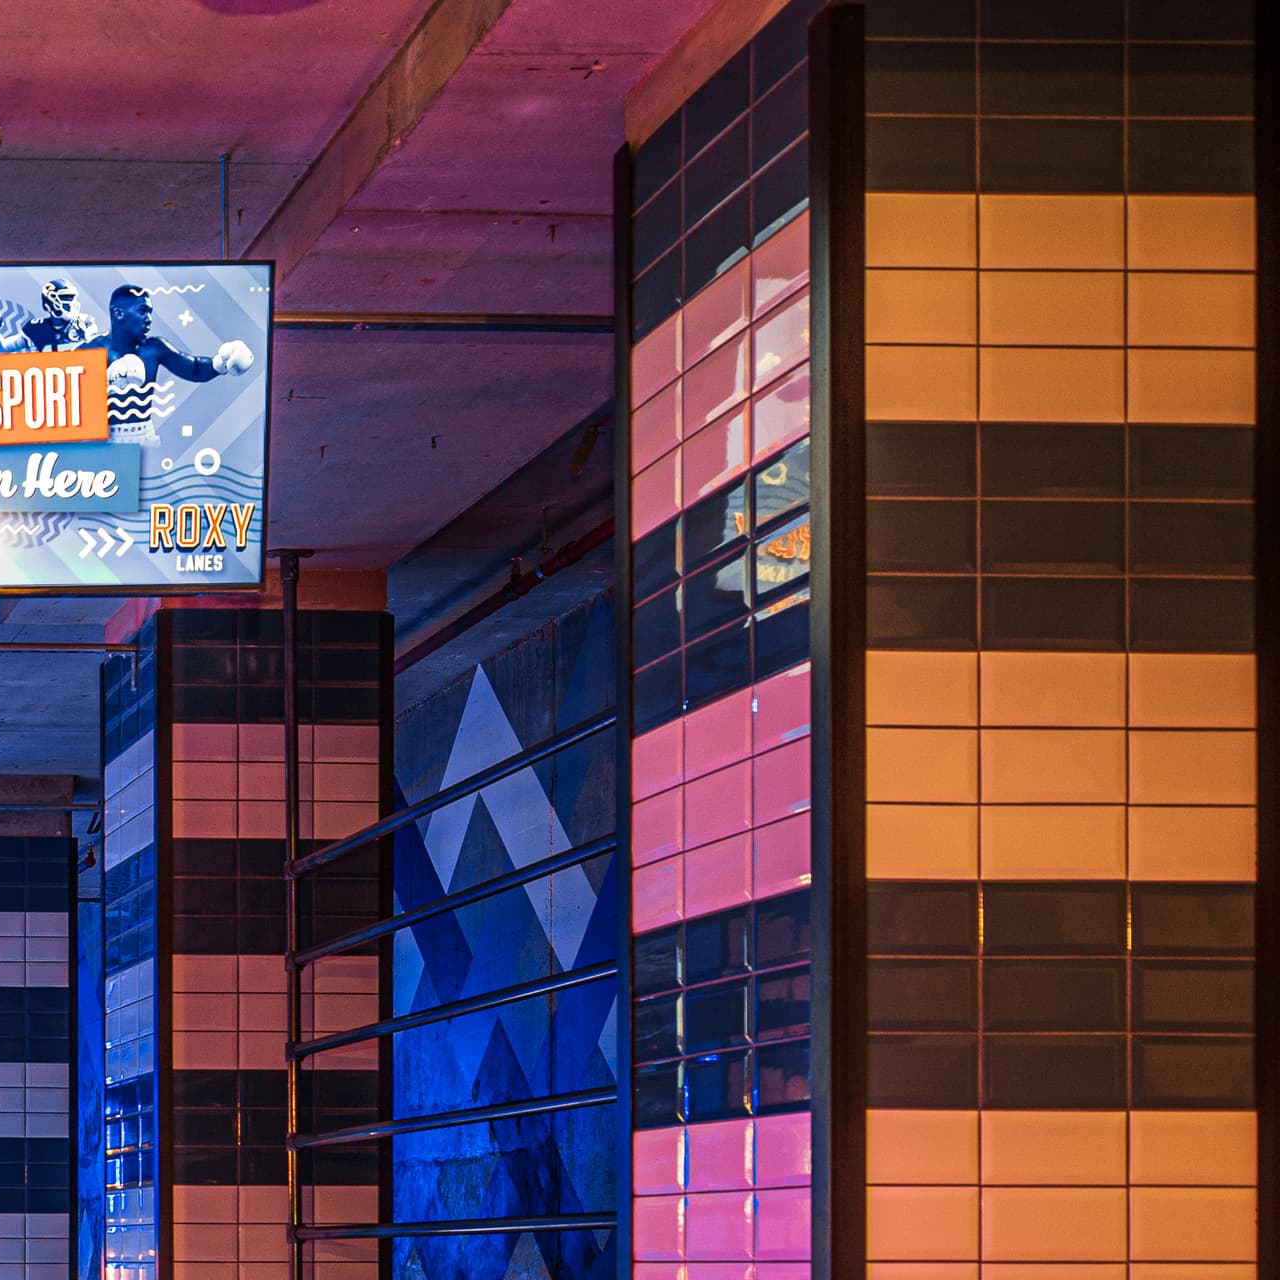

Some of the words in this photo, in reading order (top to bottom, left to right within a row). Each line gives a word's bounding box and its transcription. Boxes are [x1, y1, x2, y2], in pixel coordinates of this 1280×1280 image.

[21, 452, 119, 500] Here
[148, 502, 257, 554] ROXY
[175, 554, 223, 572] LANES
